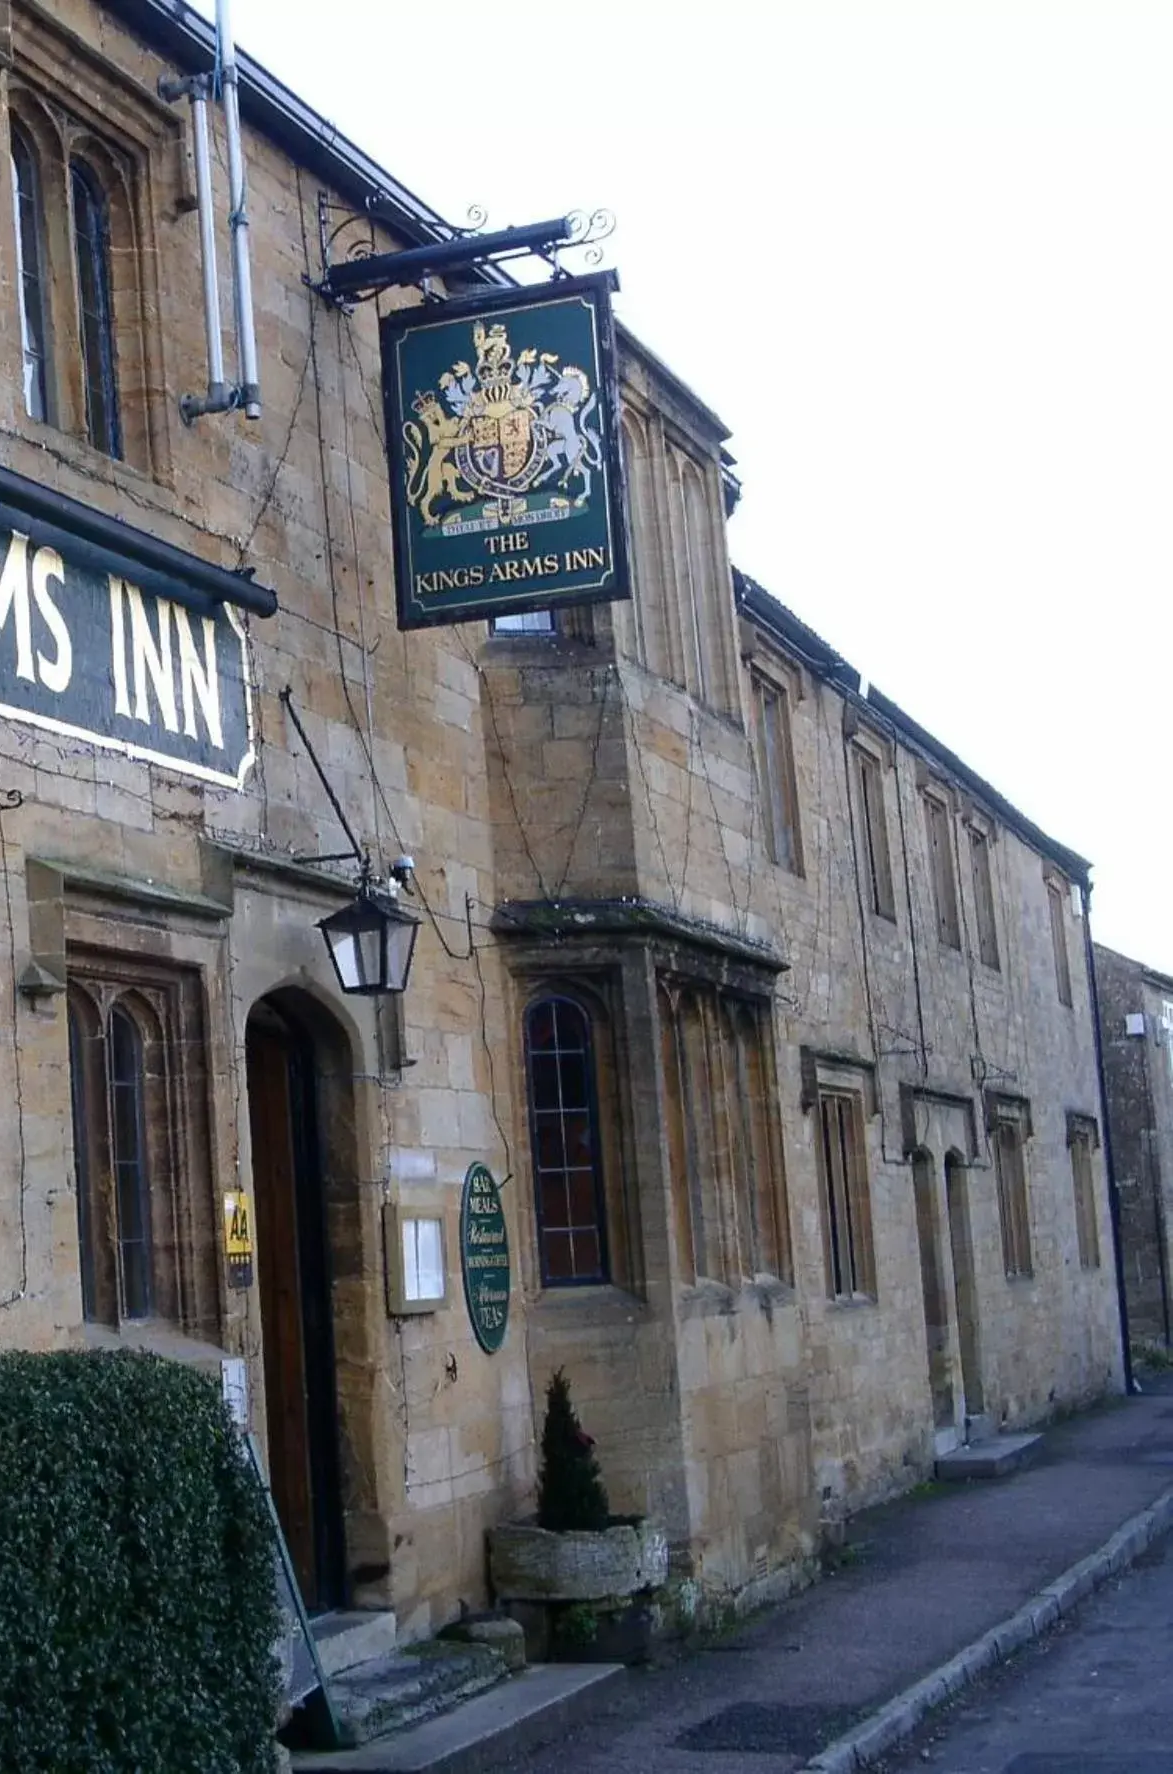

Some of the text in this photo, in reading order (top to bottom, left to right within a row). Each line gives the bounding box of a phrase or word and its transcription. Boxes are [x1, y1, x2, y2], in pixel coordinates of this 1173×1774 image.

[484, 531, 529, 555] THE
[415, 546, 605, 594] KINGS ARMS INN
[108, 574, 224, 750] INN
[230, 1204, 250, 1242] AA
[469, 1196, 500, 1214] MEALS
